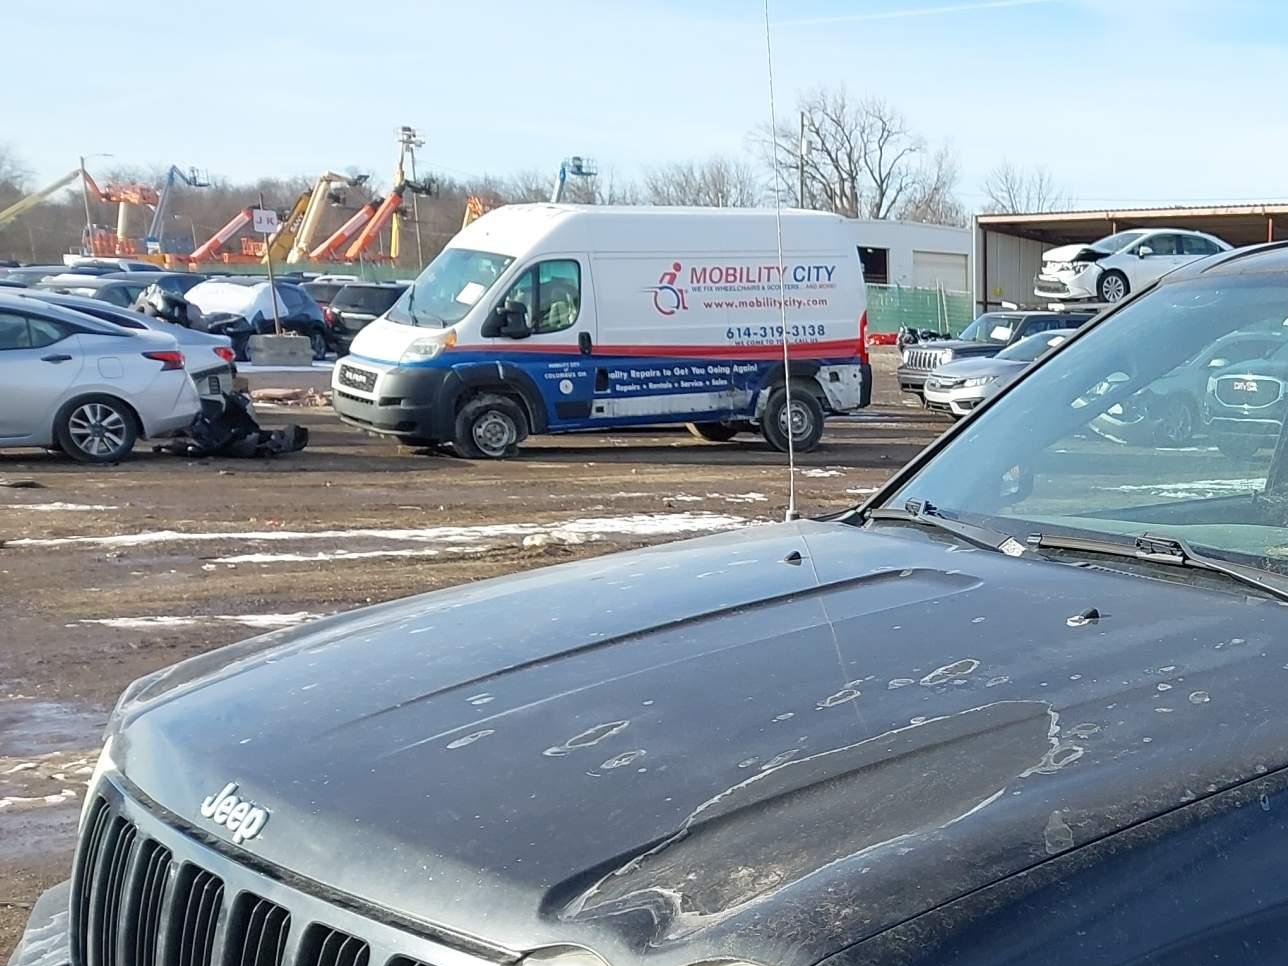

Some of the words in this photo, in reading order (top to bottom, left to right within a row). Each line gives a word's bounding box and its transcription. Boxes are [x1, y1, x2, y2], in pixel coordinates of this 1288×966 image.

[690, 266, 787, 284] MOBILITY
[793, 265, 836, 283] CITY
[703, 296, 828, 310] www.mobilitycity.com
[726, 324, 826, 340] 614-319-3138
[630, 368, 661, 380] Repairs
[662, 368, 672, 376] to
[673, 366, 688, 376] Get
[690, 366, 705, 375] You
[707, 364, 731, 375] Going
[201, 781, 270, 844] Jeep
